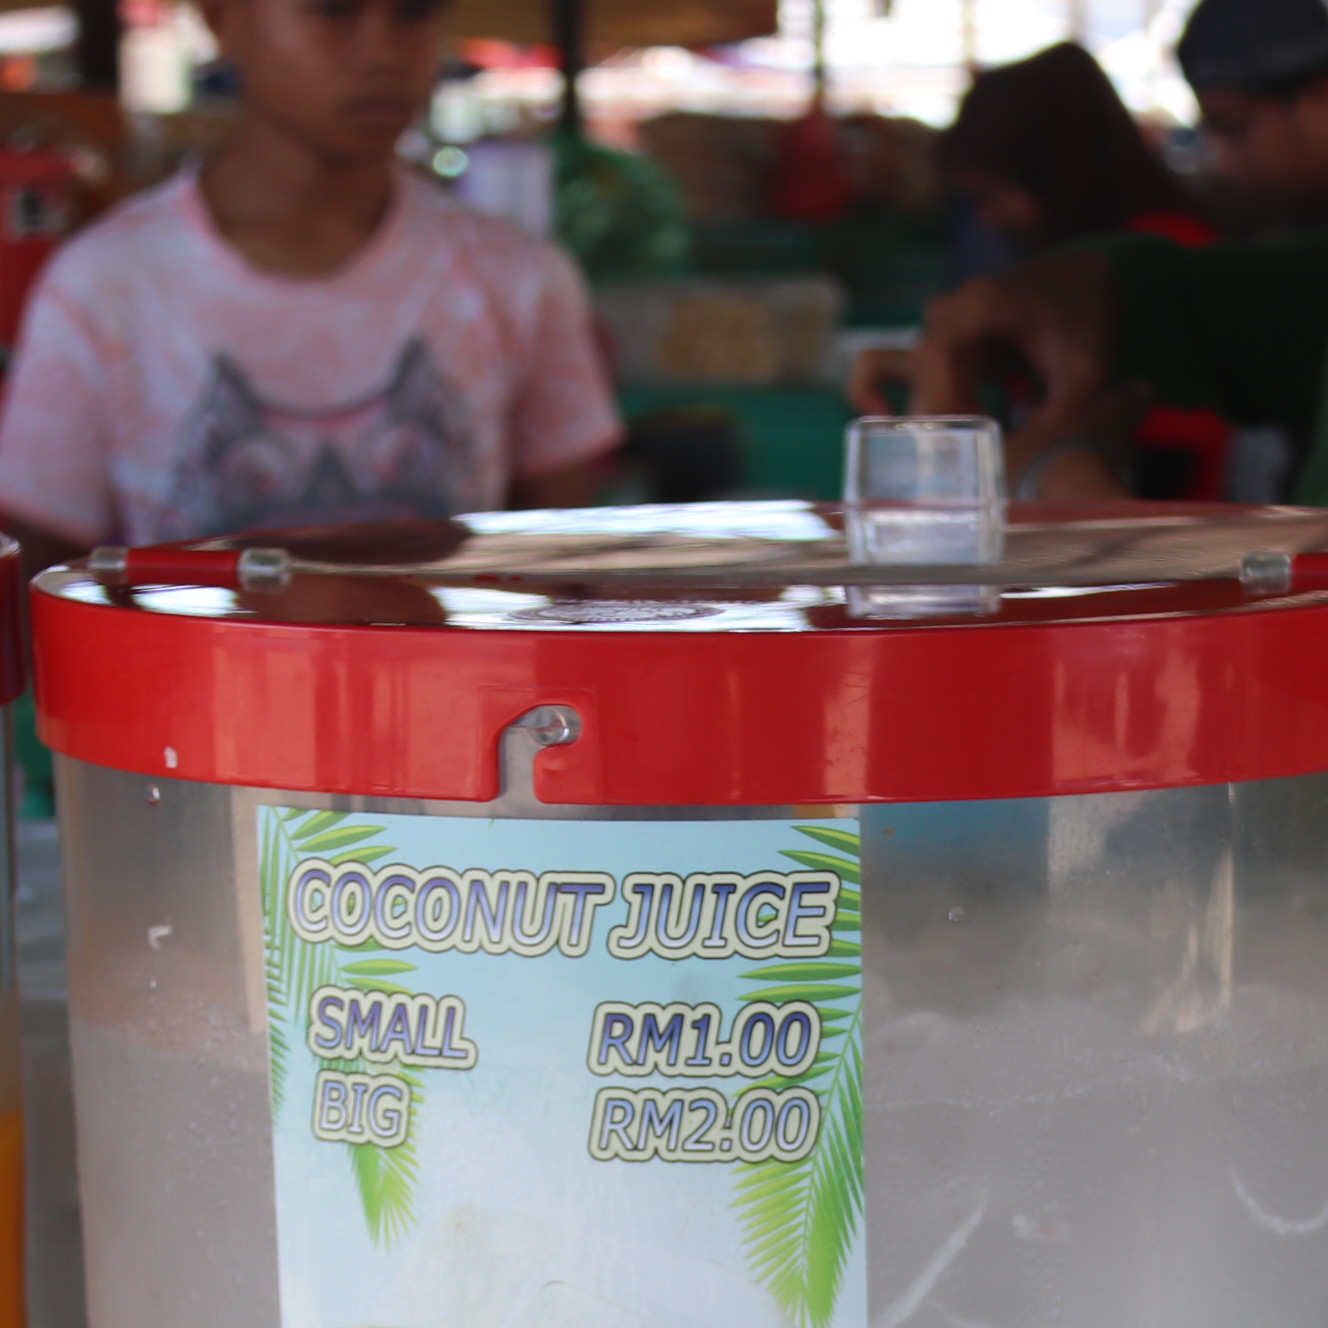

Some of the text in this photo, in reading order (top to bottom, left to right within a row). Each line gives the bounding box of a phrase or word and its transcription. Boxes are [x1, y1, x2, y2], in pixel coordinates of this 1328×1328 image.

[292, 864, 836, 954] COCONUT JUICE
[312, 990, 816, 1071] SMALL RM1.00
[316, 1074, 816, 1157] BIG RM2.00
